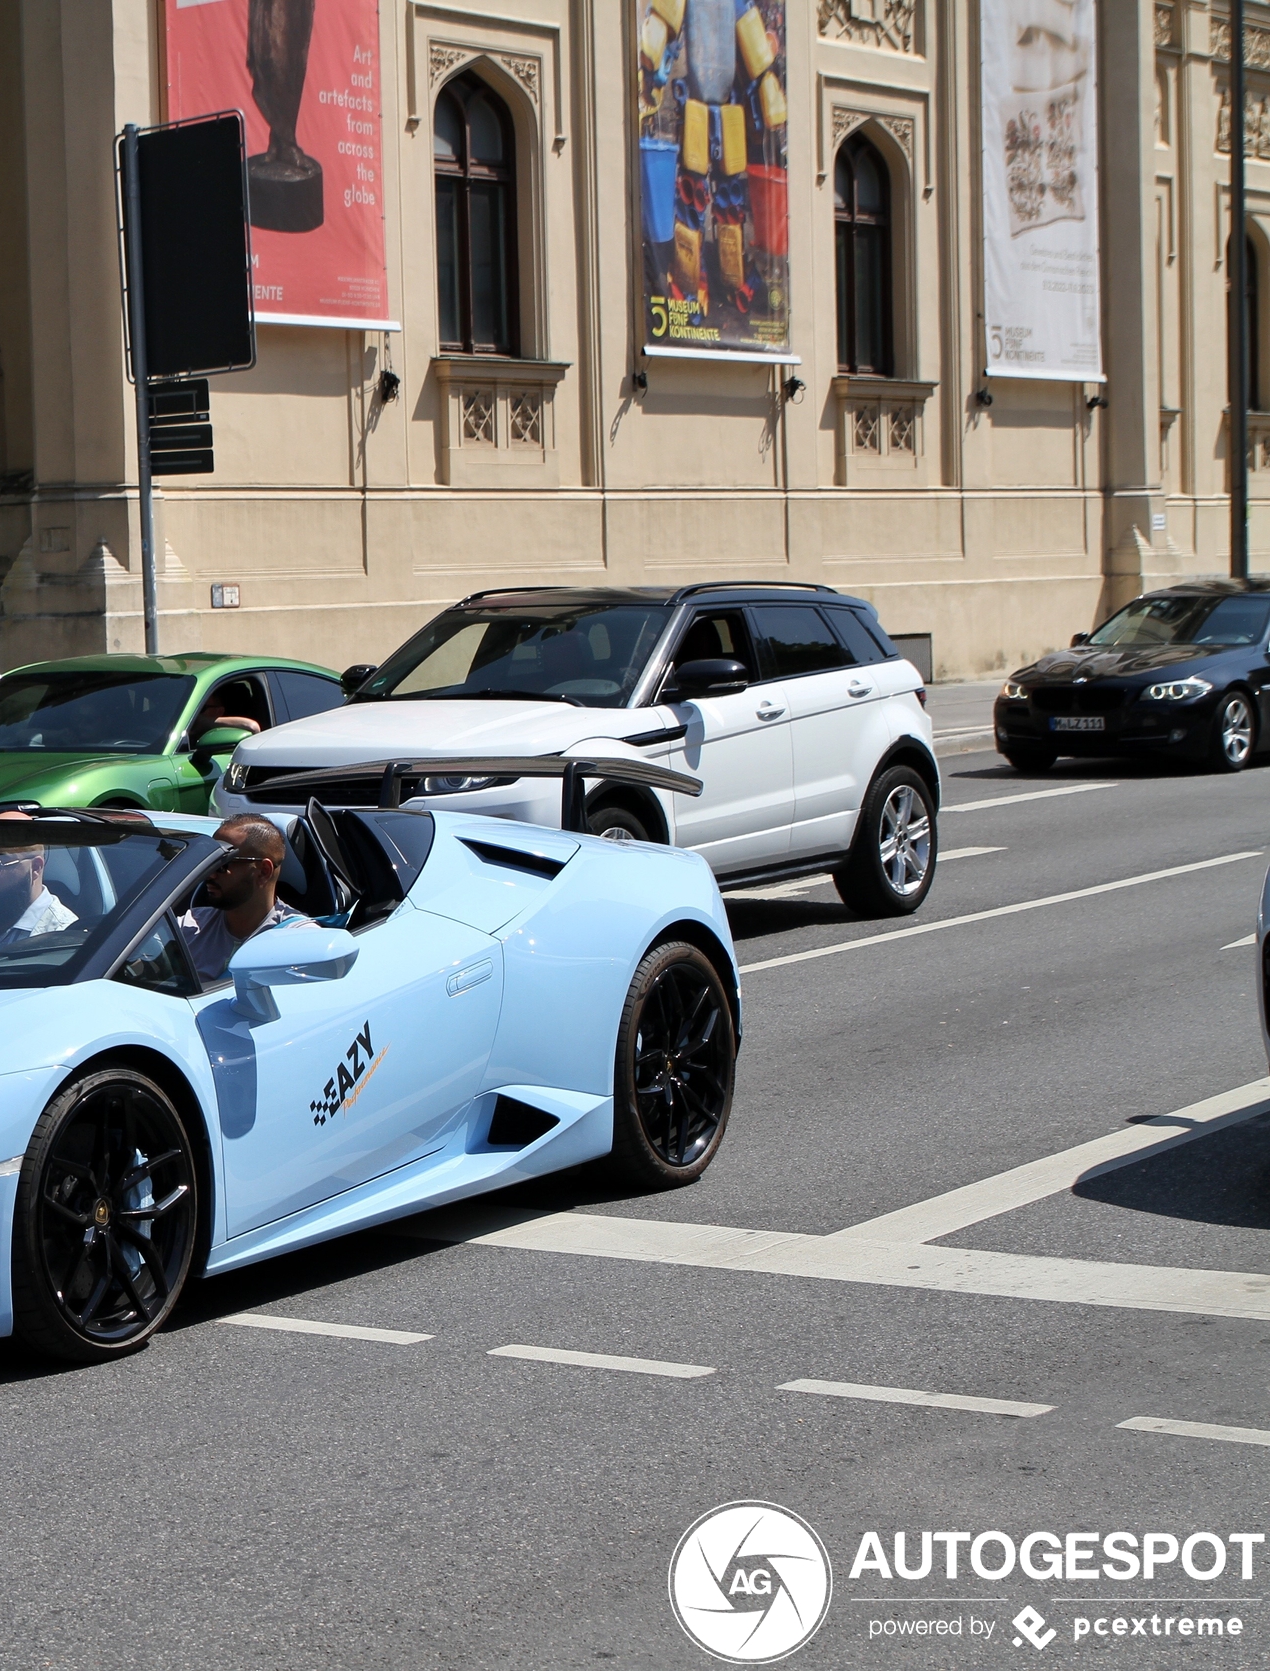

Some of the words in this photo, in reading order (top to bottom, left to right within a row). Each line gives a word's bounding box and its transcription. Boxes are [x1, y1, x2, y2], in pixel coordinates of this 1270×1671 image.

[353, 44, 372, 66] Art
[351, 71, 372, 89] and
[318, 89, 373, 113] artefacts
[346, 113, 373, 136] from
[337, 140, 374, 159] across
[356, 162, 374, 183] the
[344, 184, 375, 208] globe
[651, 296, 668, 337] 5
[667, 297, 701, 315] MUSEUM
[669, 325, 721, 341] KONTINENTE
[322, 1019, 375, 1118] EAZY
